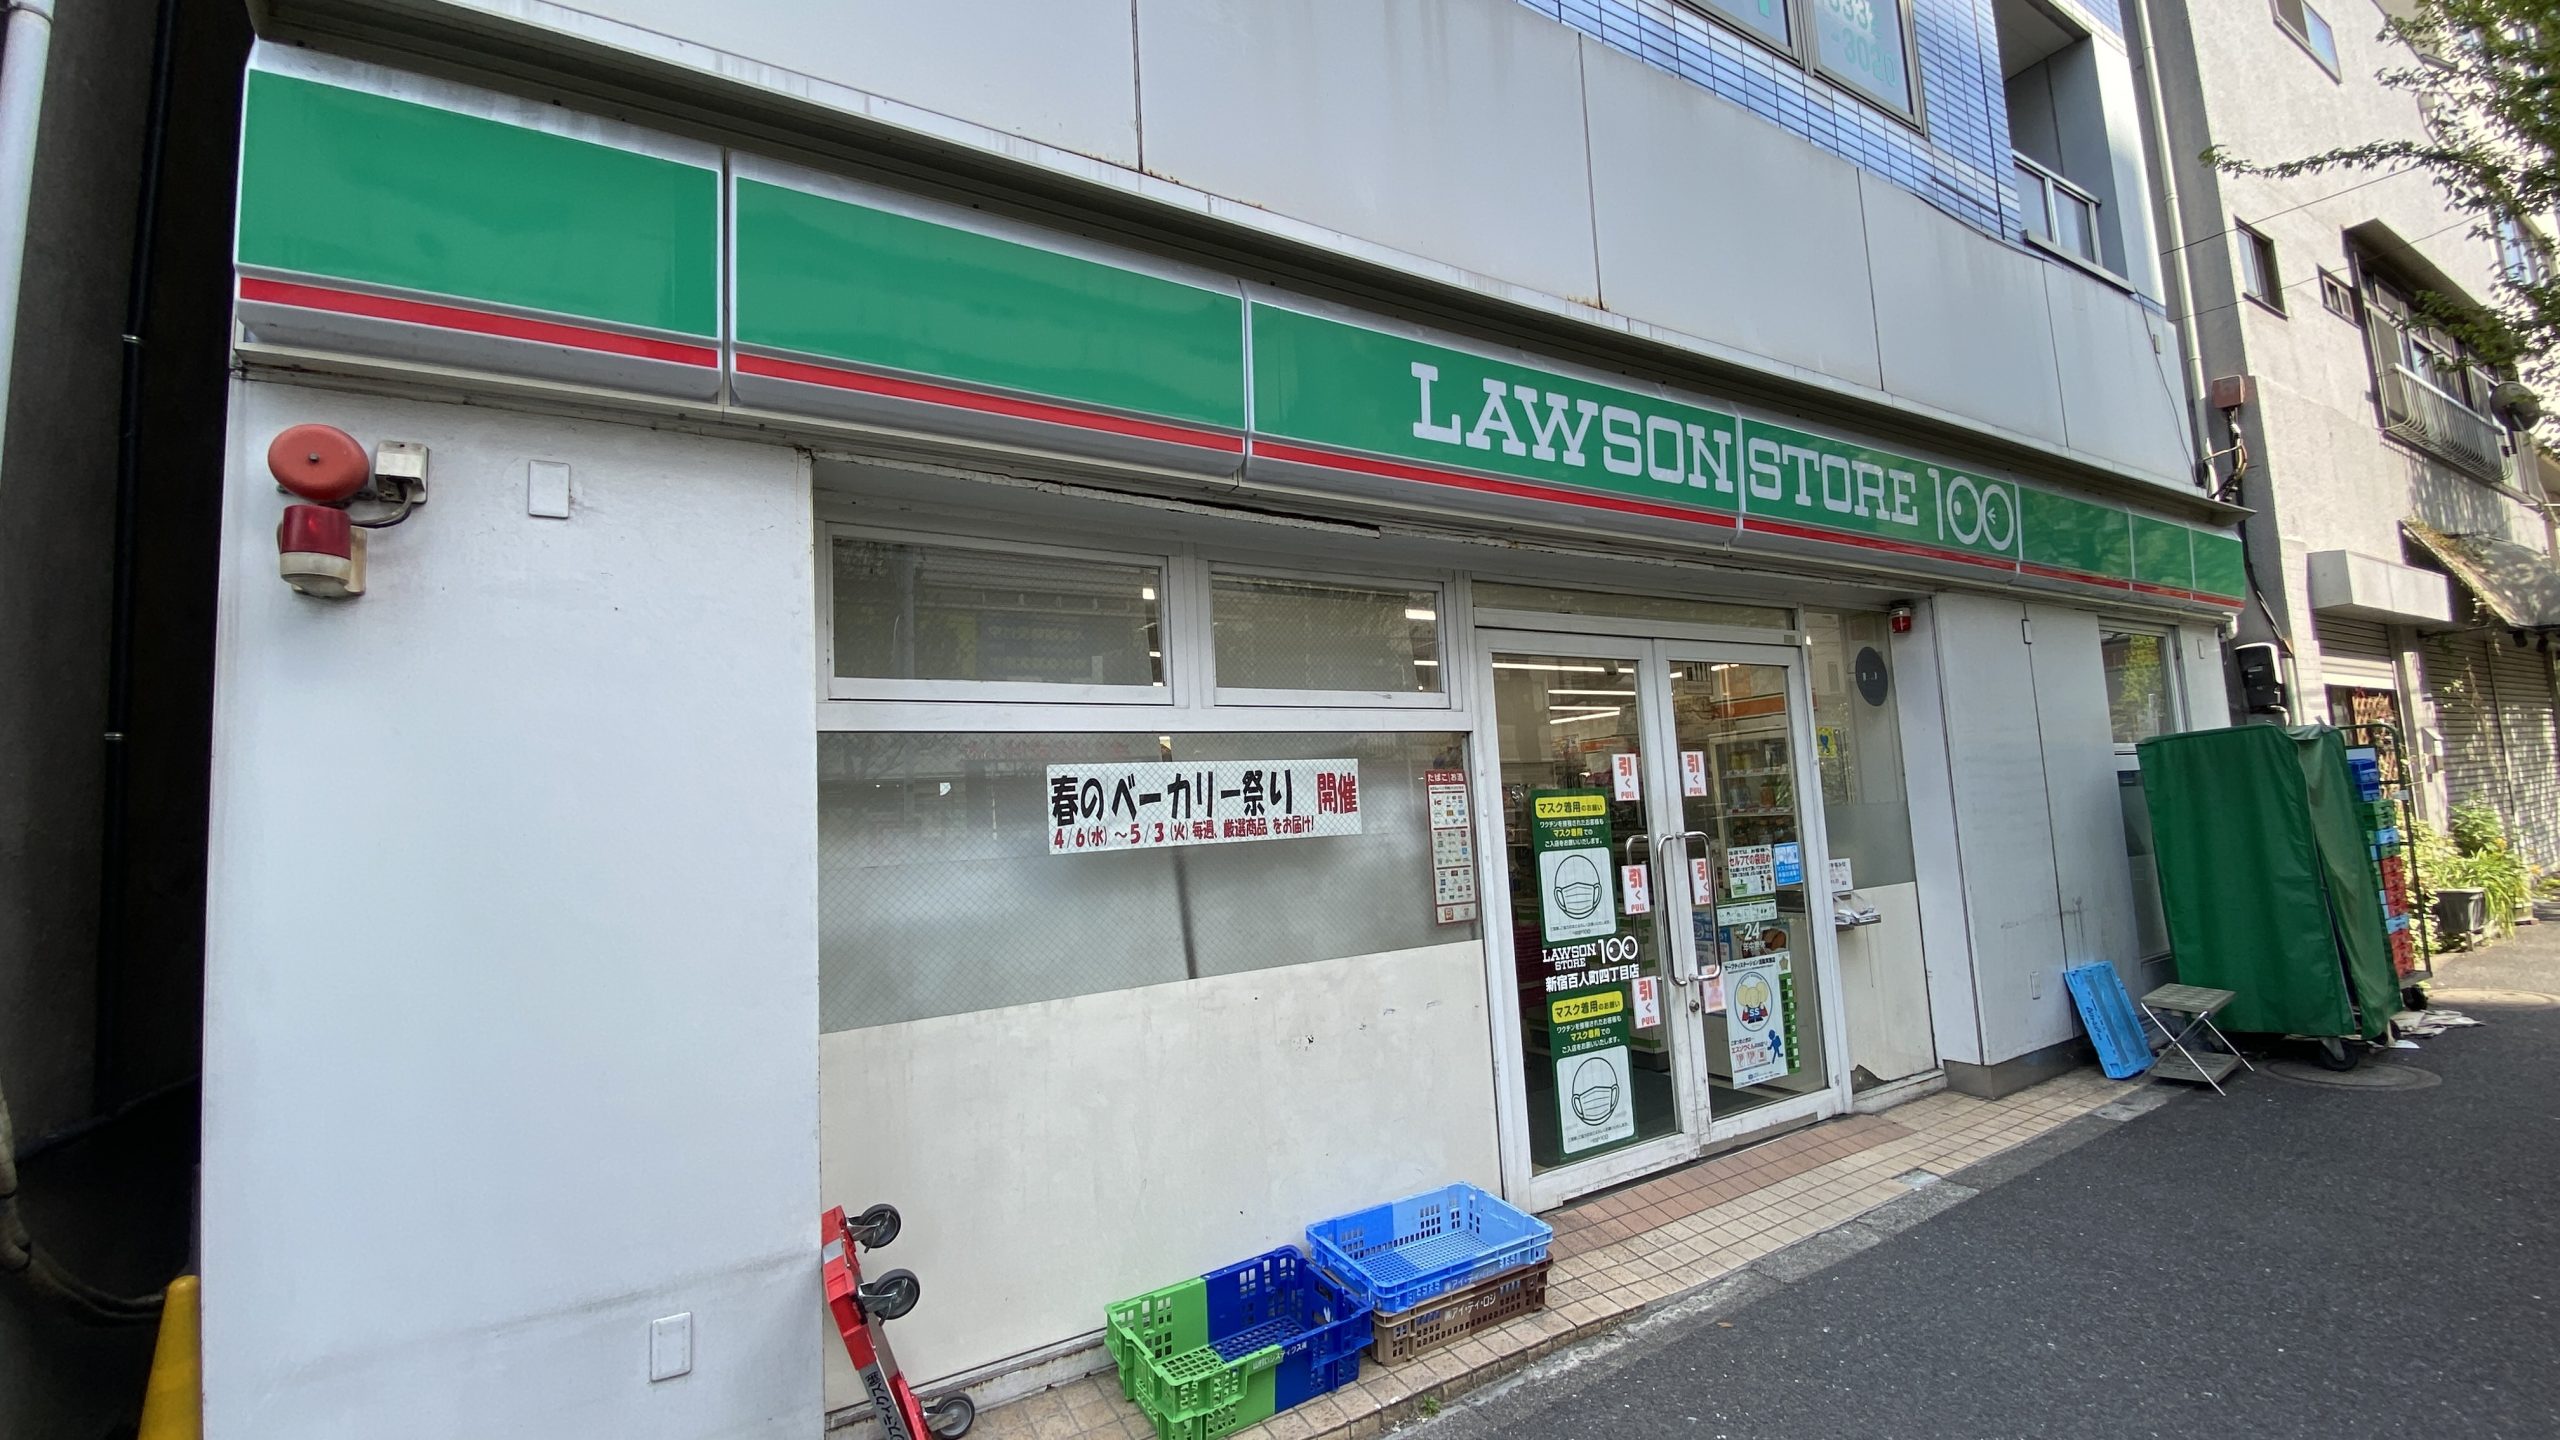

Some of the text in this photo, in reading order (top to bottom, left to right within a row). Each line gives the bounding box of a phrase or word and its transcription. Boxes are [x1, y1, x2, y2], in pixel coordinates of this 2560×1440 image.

[1411, 361, 2015, 551] LAWSON STORE 100
[1428, 773, 1448, 782] たばこ
[1618, 756, 1632, 789] 引く
[1687, 754, 1700, 785] 引く
[1051, 769, 1359, 827] 春のベーカリー祭り 開催
[1620, 791, 1635, 799] PULL
[1689, 787, 1703, 795] PULL
[1538, 802, 1603, 813] マスク着用のお願い
[1628, 868, 1643, 900] 引く
[1631, 904, 1646, 912] PULL
[1745, 922, 1760, 940] 24
[1542, 936, 1638, 964] LAWSON 100
[1555, 957, 1586, 971] STORE
[1545, 963, 1640, 992] 新宿百人町四丁目店
[1638, 979, 1653, 1013] 引く
[1555, 1000, 1620, 1018] マスク着用のお願い
[1641, 1016, 1656, 1025] PULL
